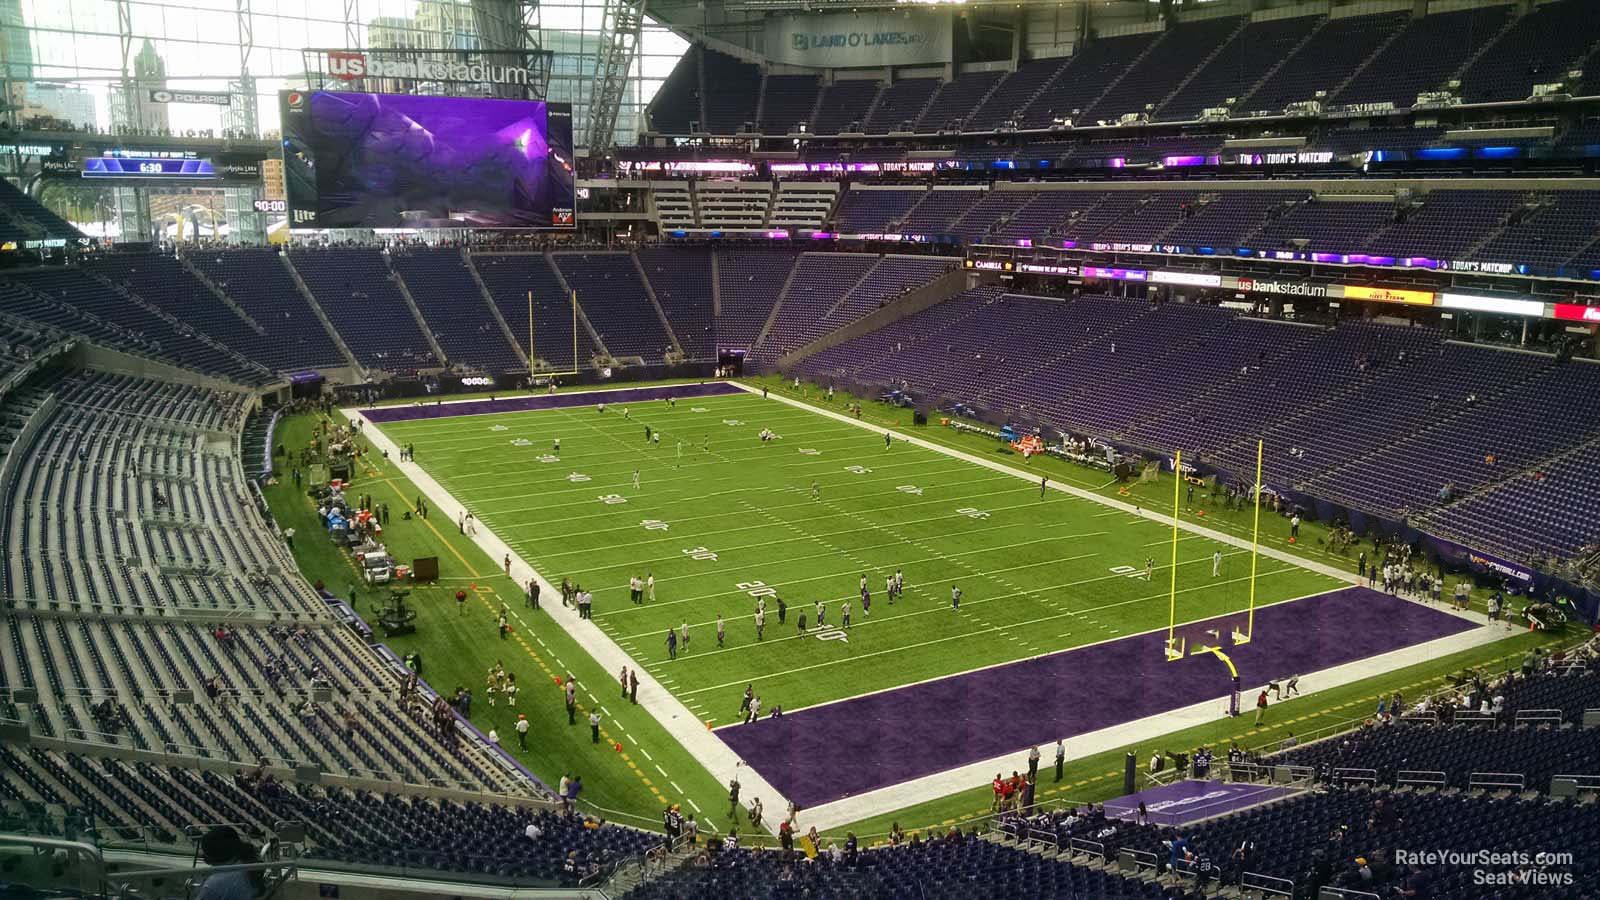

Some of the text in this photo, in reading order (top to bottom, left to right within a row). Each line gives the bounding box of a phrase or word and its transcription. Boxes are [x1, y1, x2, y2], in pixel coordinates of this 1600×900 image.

[812, 34, 846, 48] LAND
[173, 92, 229, 104] POLARIS
[18, 146, 52, 155] MATCHUP
[1266, 152, 1333, 164] TODAY'S MATCHUP
[140, 163, 163, 173] 6:30
[883, 162, 907, 171] TODAY'S
[908, 162, 934, 171] MATCHUP
[577, 188, 589, 199] 40
[254, 200, 286, 212] 90:00
[293, 209, 316, 223] Lite
[975, 260, 1002, 270] CAMBRIA
[1452, 261, 1513, 273] TODAY'S MATCHUP
[736, 580, 774, 597] 20
